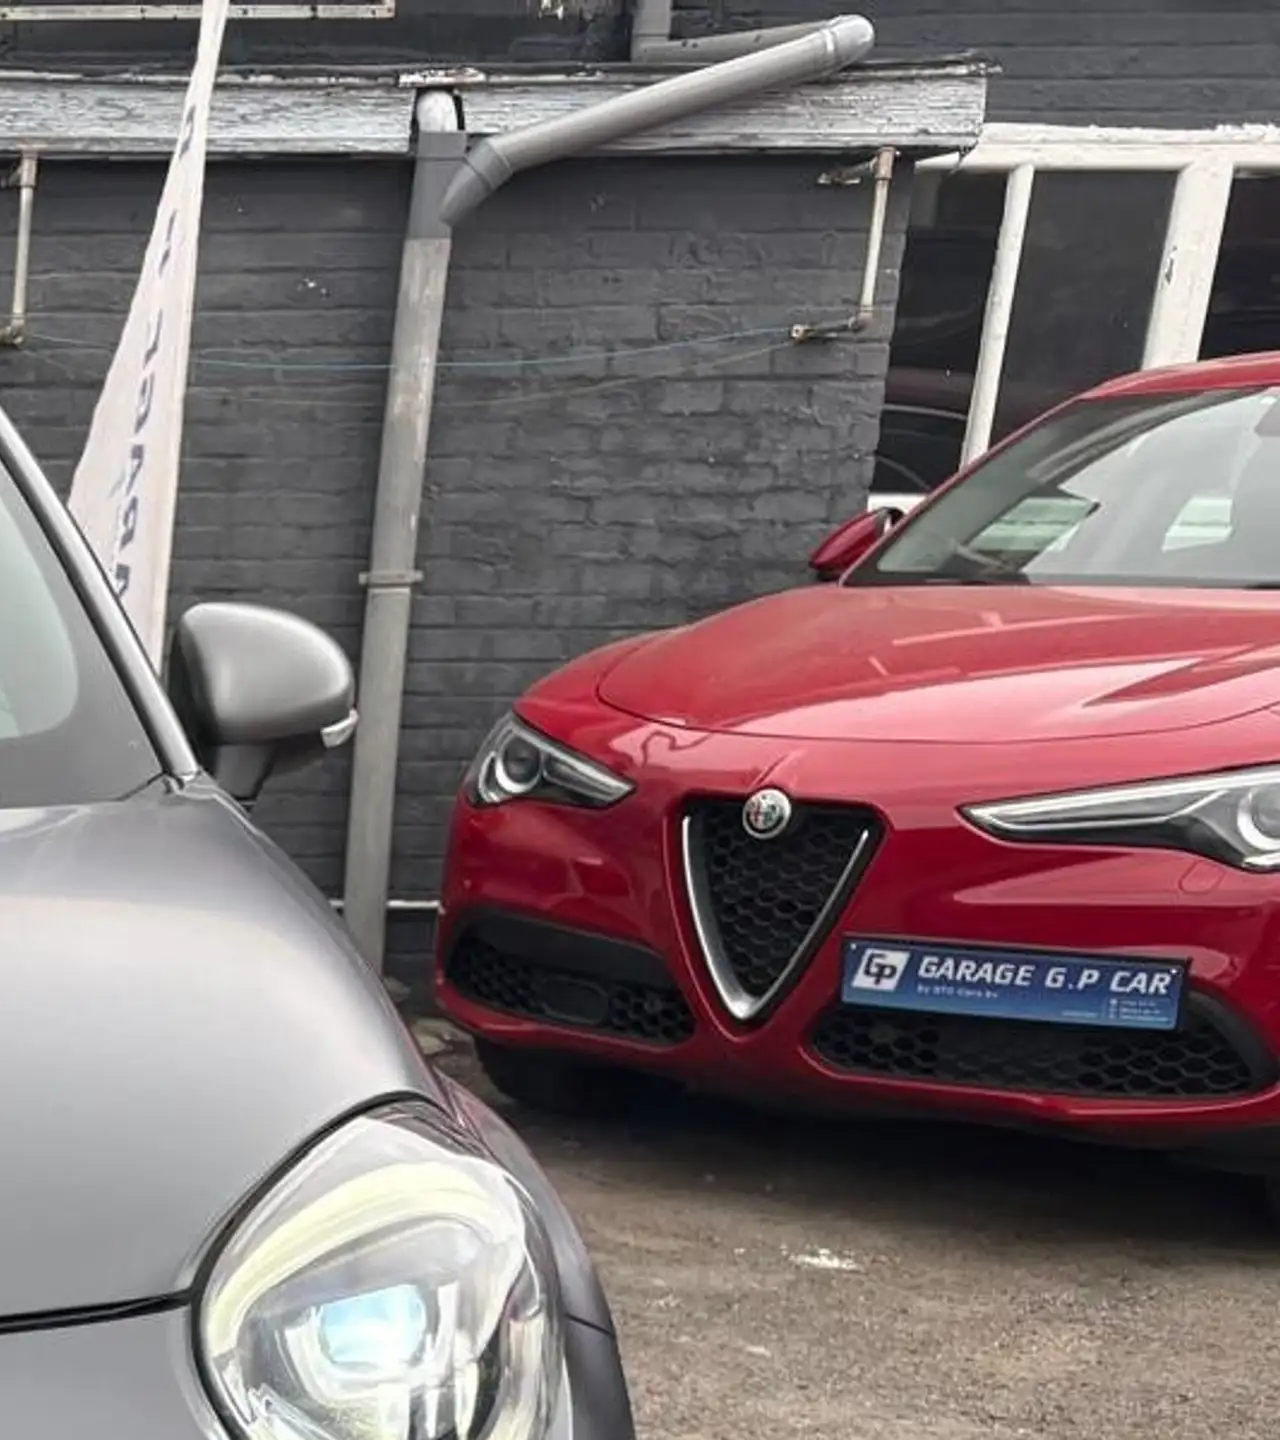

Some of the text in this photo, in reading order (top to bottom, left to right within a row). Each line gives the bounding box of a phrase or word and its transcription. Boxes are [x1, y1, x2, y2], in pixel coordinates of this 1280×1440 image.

[918, 955, 1036, 987] GARAGE
[1044, 966, 1100, 991] G.P
[1109, 970, 1172, 995] CAR
